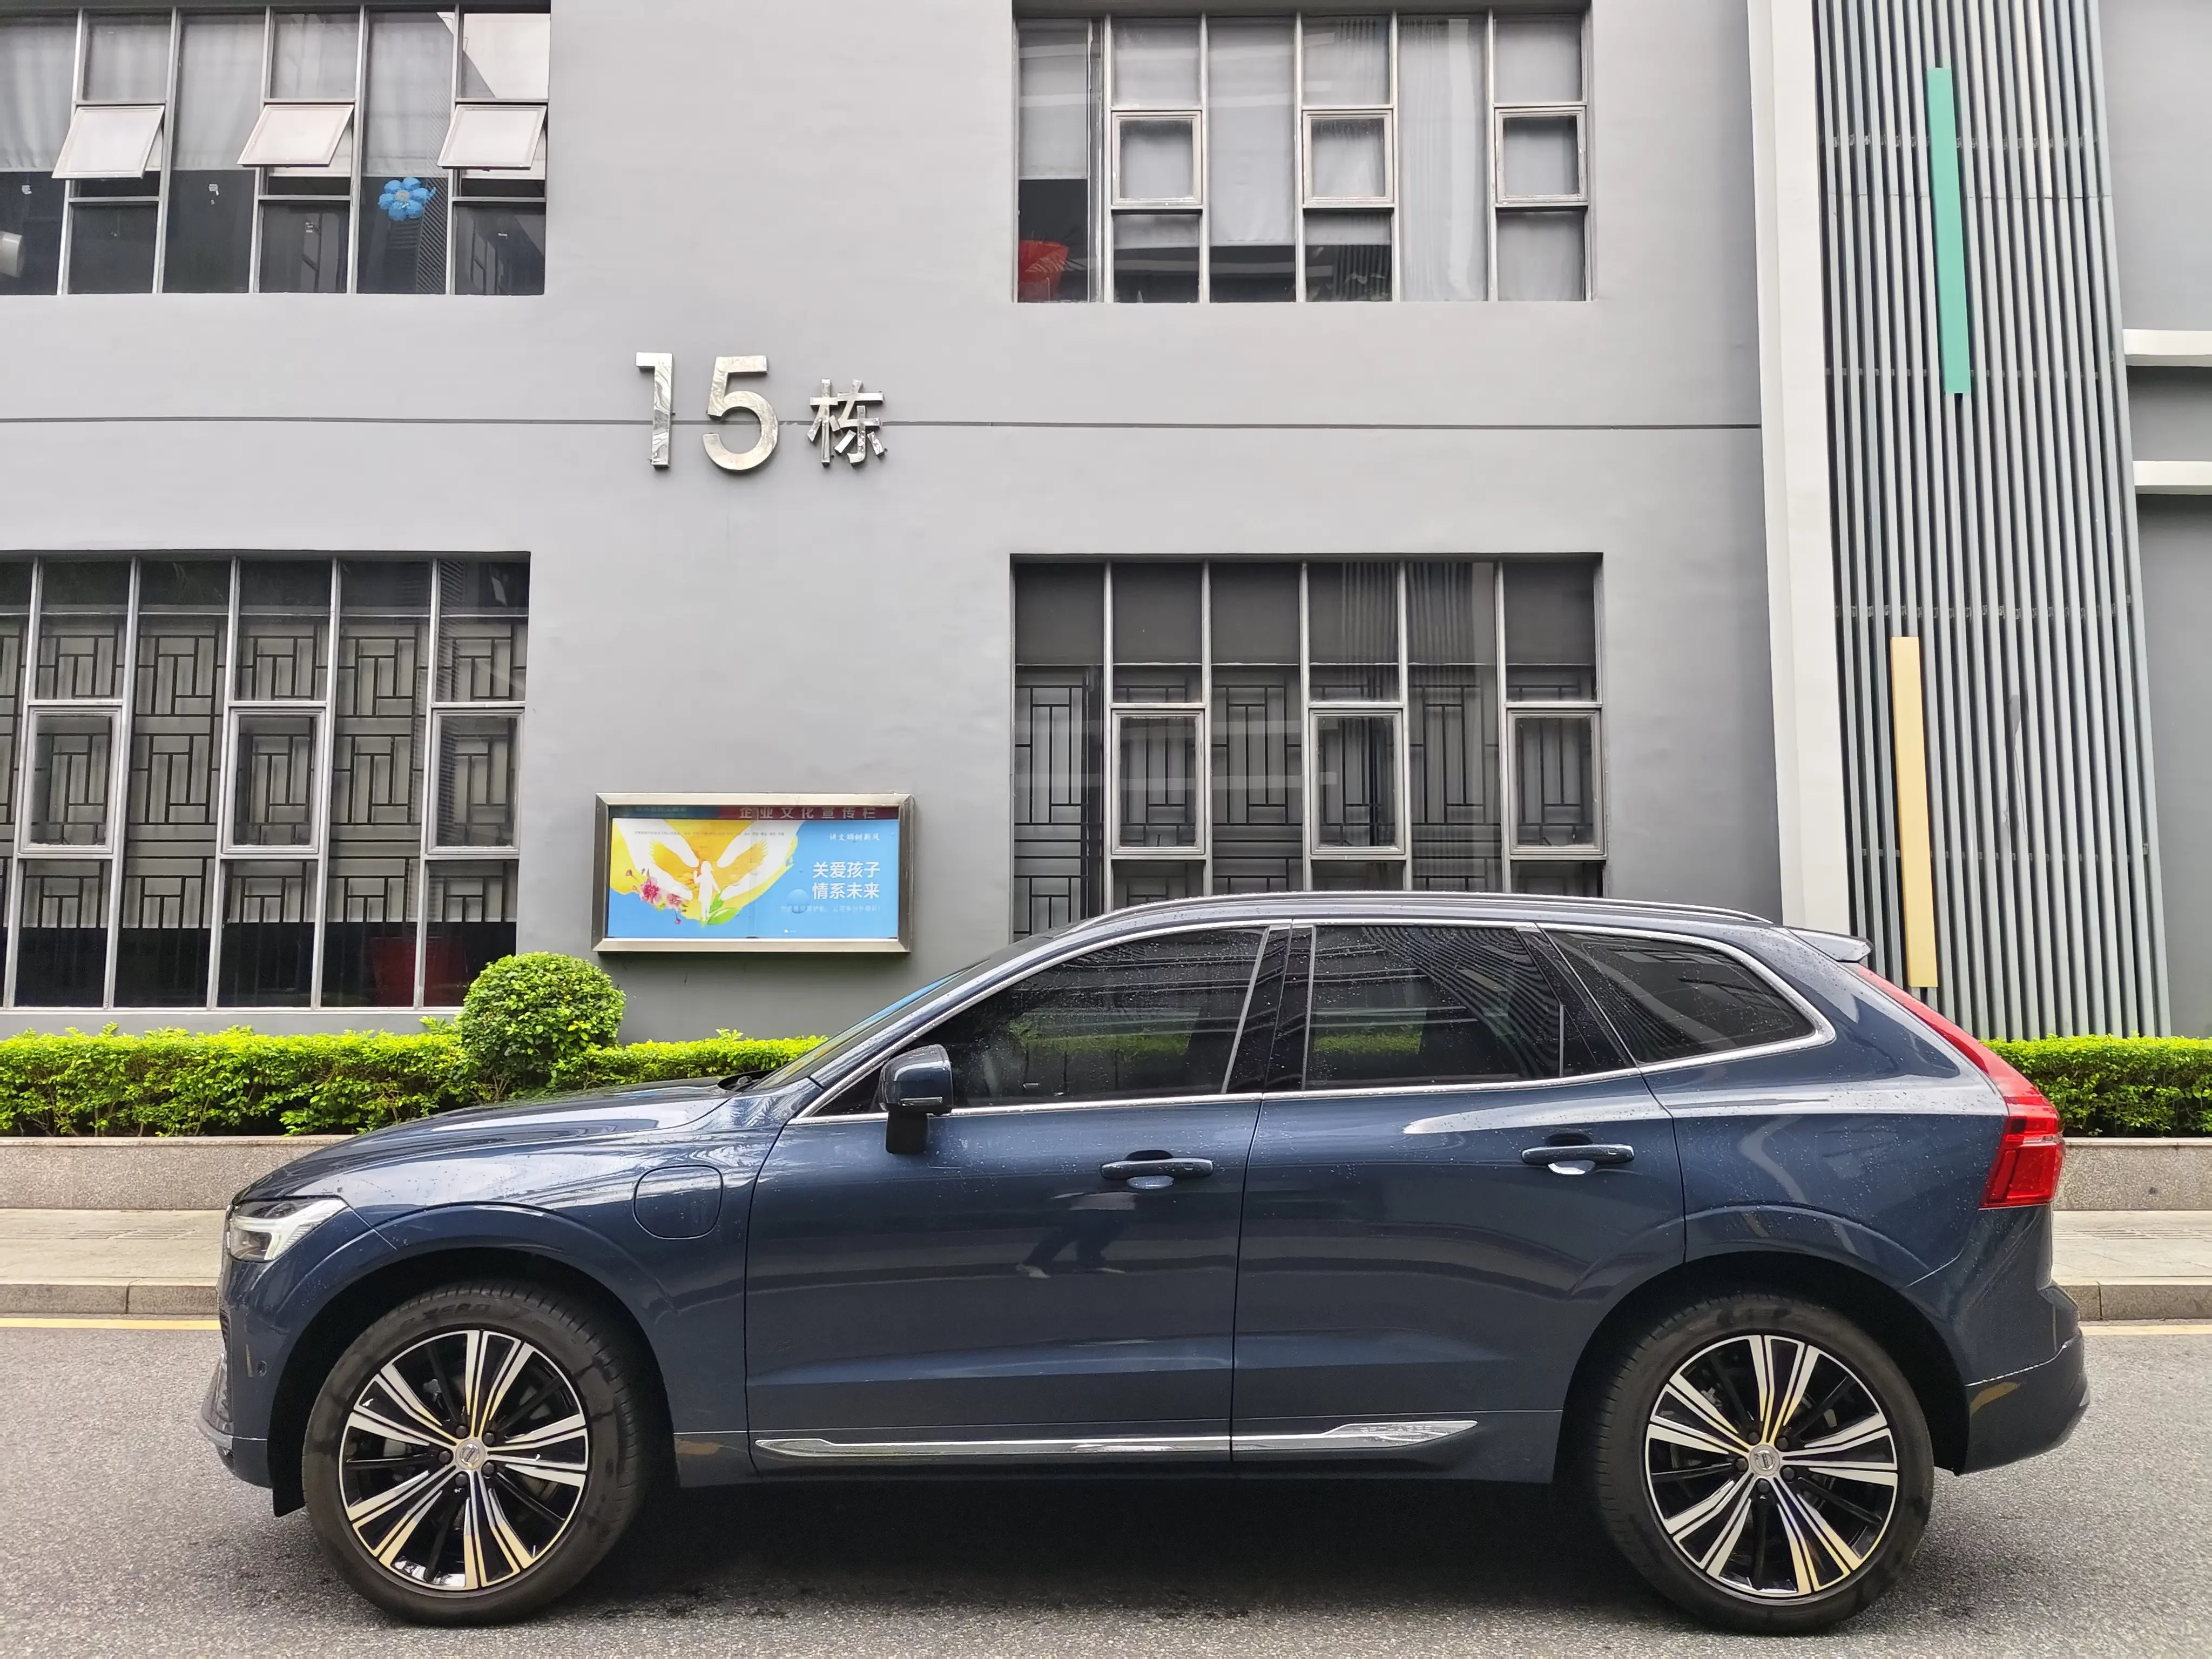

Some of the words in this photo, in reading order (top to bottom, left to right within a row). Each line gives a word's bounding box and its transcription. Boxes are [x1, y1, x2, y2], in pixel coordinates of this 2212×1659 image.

[636, 352, 886, 471] 15栋
[739, 806, 876, 819] 企业文化宣传栏
[812, 861, 880, 879] 关爱孩子
[812, 882, 880, 900] 情系未来
